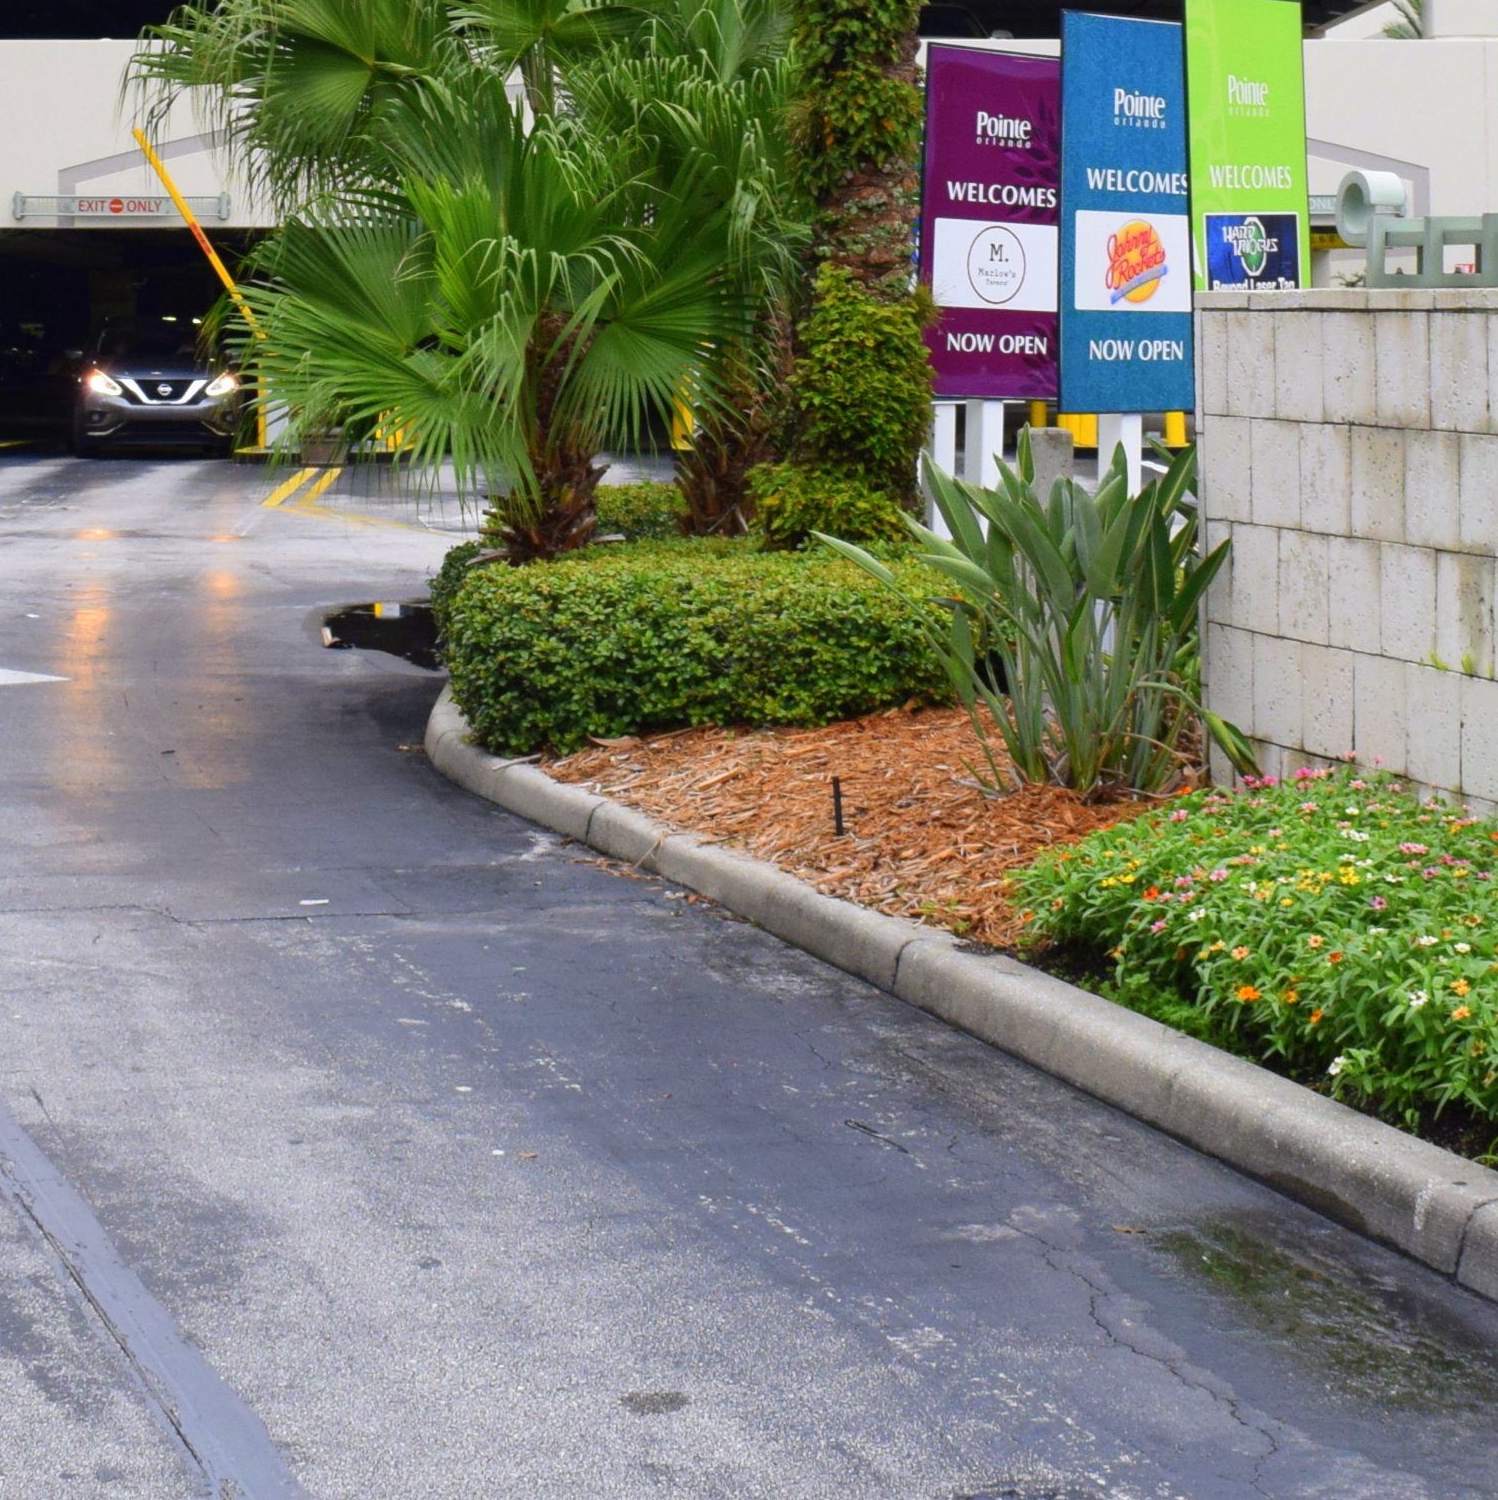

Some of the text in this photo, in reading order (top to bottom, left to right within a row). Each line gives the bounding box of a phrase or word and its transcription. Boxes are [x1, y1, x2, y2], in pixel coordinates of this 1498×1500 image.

[1227, 74, 1269, 106] Pointe
[1113, 87, 1167, 119] Pointe
[975, 110, 1032, 140] Pointe
[1113, 116, 1167, 129] orlando
[975, 136, 1032, 149] orlando
[1086, 167, 1188, 196] WELCOMES
[1209, 165, 1293, 189] WELCOMES
[946, 180, 1057, 209] WELCOMES
[1309, 197, 1337, 211] ONL
[78, 200, 163, 212] EXIT ONLY
[989, 243, 1009, 263] M.
[978, 267, 1016, 278] Marlow's
[946, 332, 1048, 355] NOW OPEN
[1089, 340, 1183, 361] NOW OPEN
